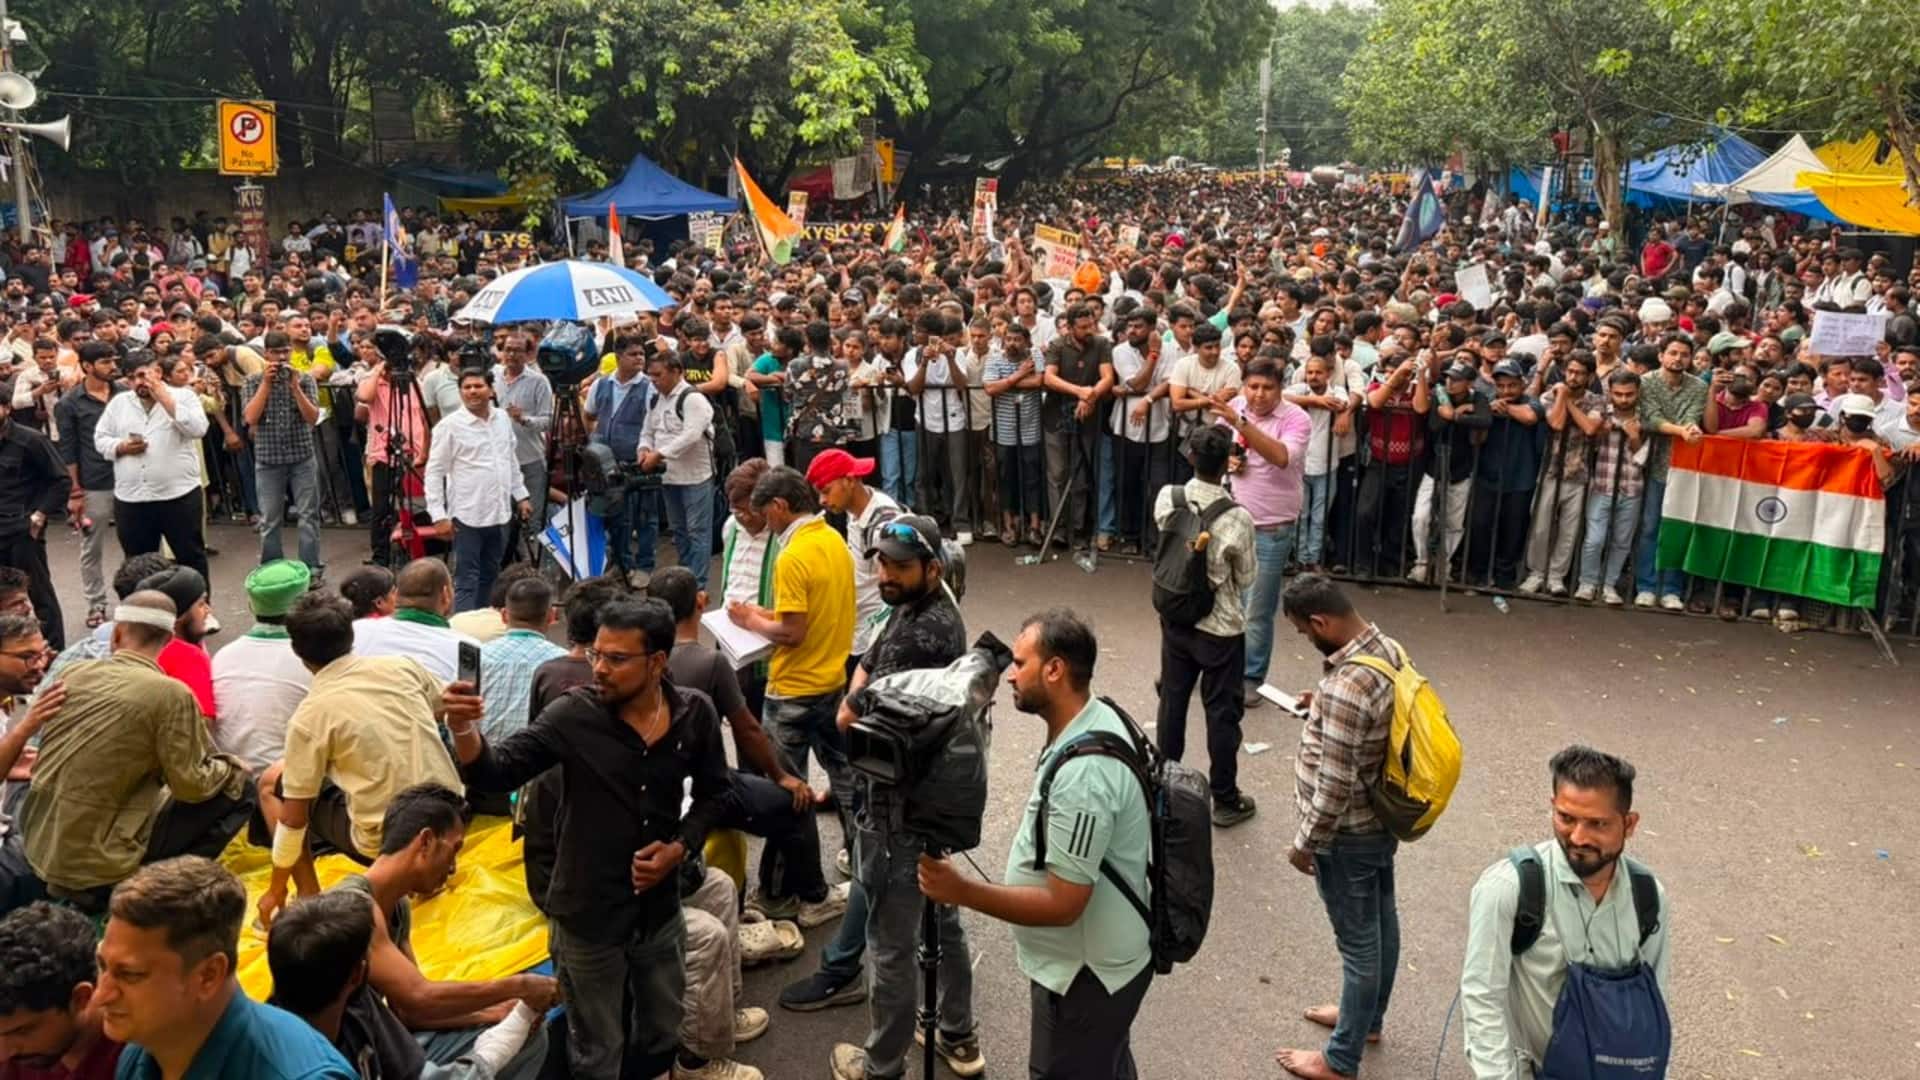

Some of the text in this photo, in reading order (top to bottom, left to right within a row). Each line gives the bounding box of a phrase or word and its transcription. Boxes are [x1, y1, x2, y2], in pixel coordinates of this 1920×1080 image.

[241, 150, 254, 158] No
[800, 226, 836, 242] KYS
[590, 286, 630, 305] ANI
